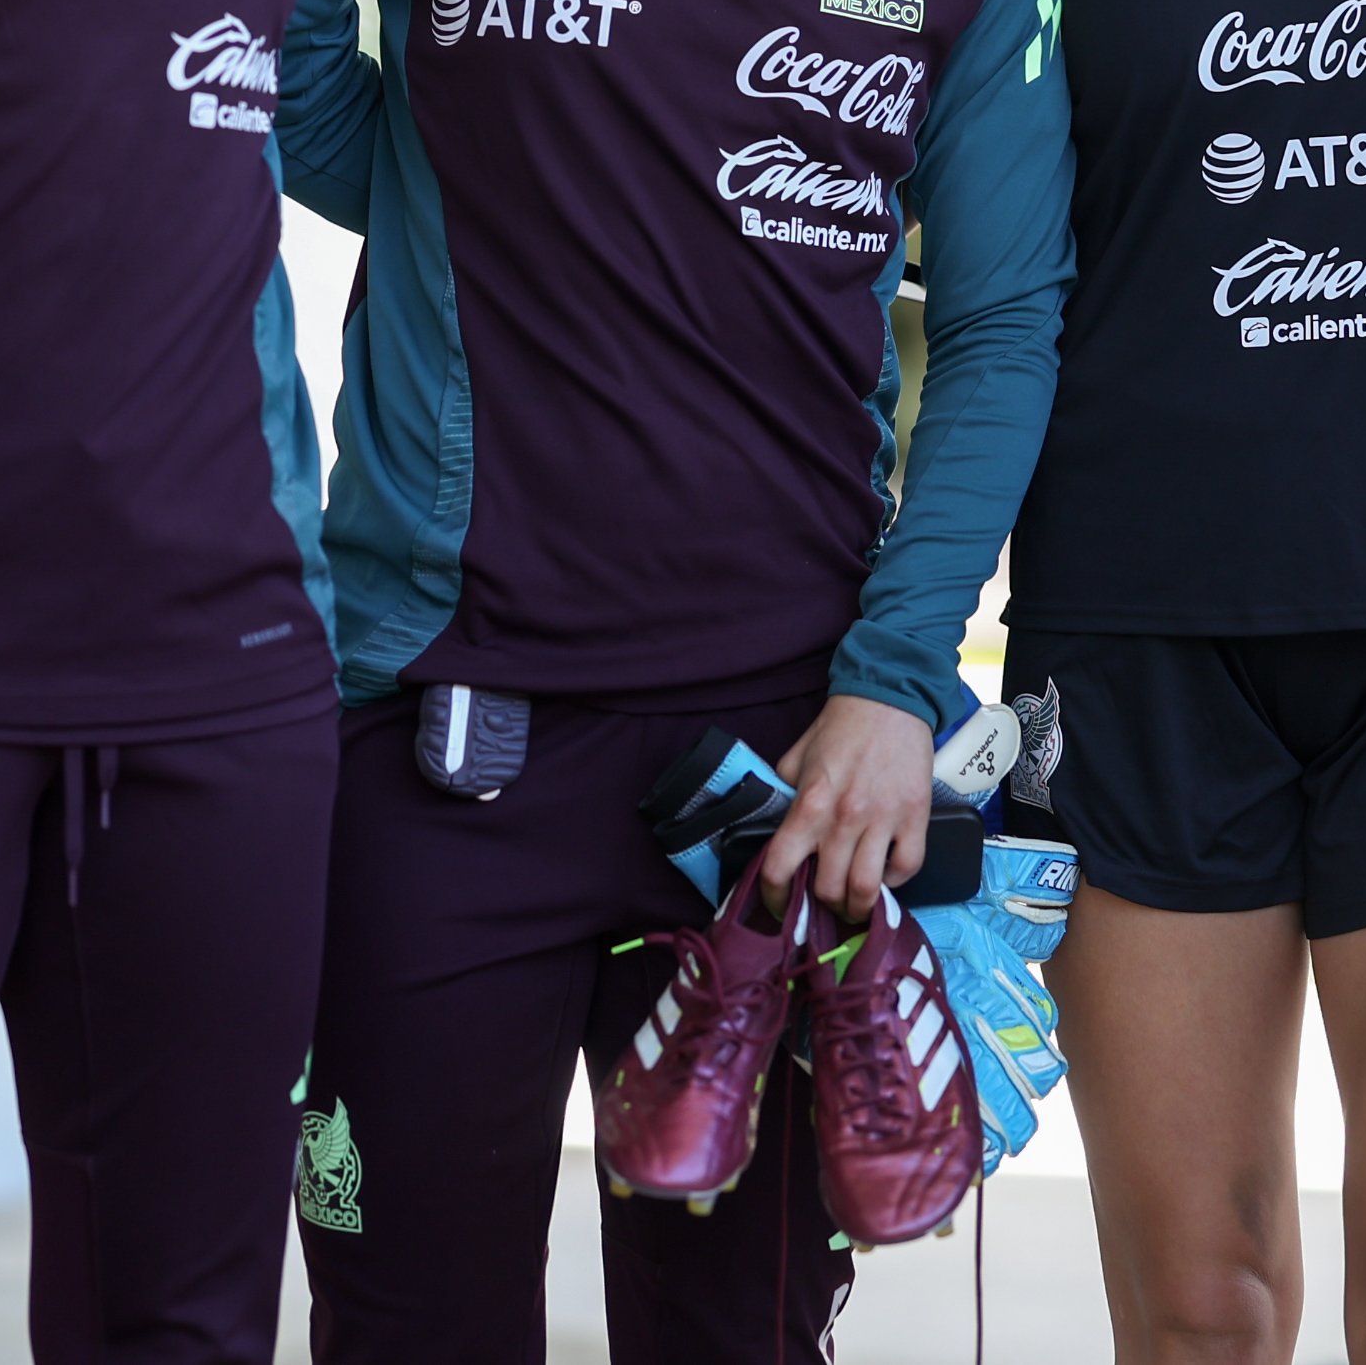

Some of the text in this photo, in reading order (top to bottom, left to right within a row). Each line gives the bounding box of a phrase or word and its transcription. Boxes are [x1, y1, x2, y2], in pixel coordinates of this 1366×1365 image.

[736, 25, 925, 136] Coca-Cola
[716, 134, 885, 218] Caliente
[762, 214, 889, 253] caliente.mx
[958, 728, 999, 776] FORMULA
